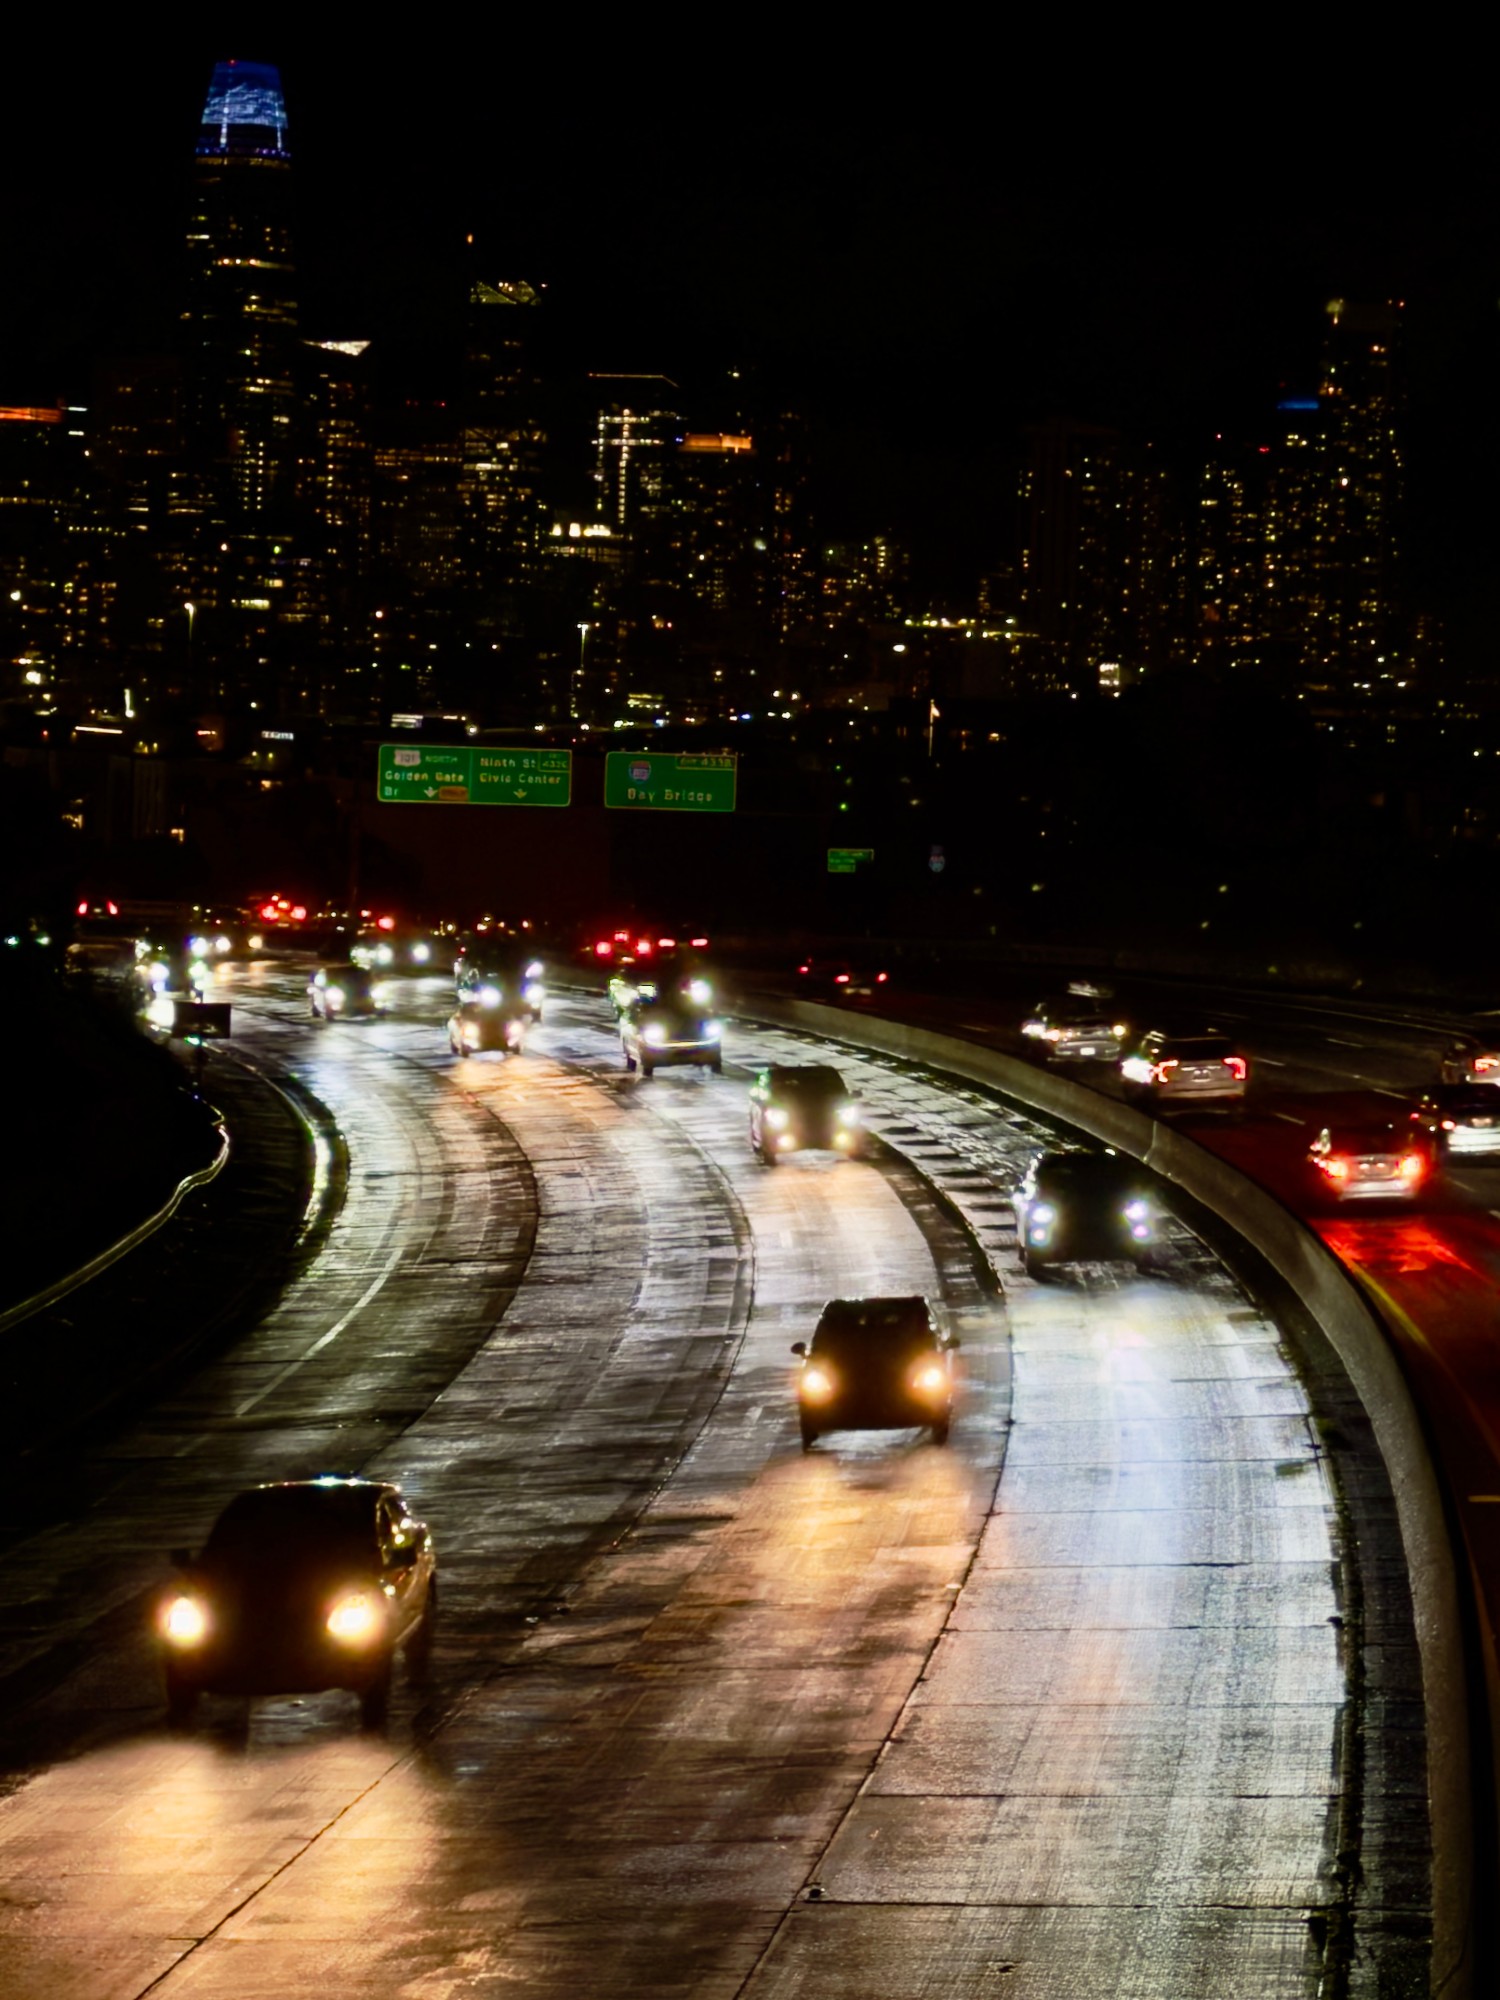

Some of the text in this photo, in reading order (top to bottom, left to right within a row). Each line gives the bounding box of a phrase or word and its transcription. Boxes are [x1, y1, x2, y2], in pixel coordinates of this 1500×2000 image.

[480, 757, 536, 768] Ninth St
[385, 770, 464, 783] Golden Gate
[479, 772, 562, 785] Civic Center
[384, 786, 399, 797] Br
[627, 787, 713, 804] Bay Bridge
